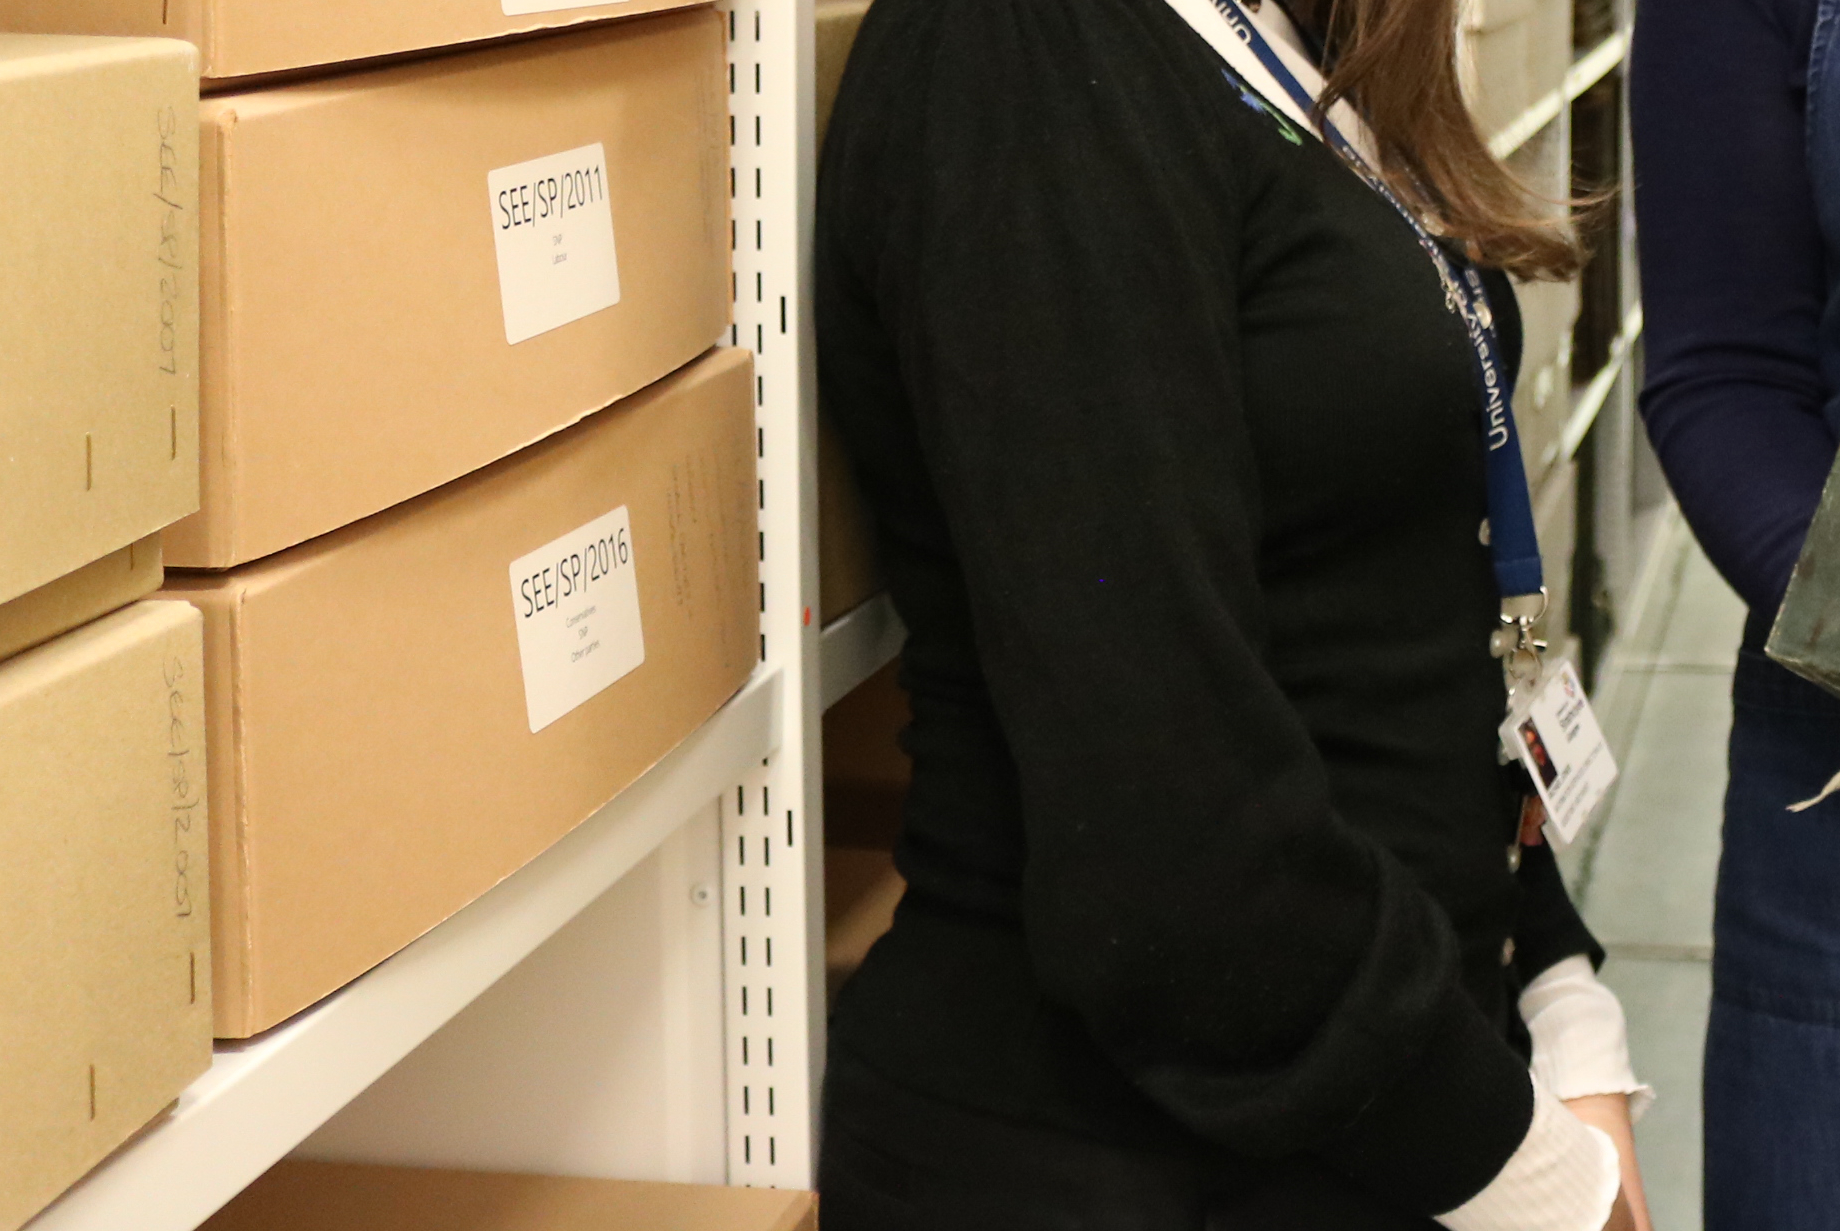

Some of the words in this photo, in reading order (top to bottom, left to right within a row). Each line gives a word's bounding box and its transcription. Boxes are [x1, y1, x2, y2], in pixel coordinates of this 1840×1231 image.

[498, 164, 604, 230] SEE/SP/2011
[1466, 311, 1509, 452] University
[520, 527, 629, 619] SEE/SP/2016
[570, 648, 585, 664] Other
